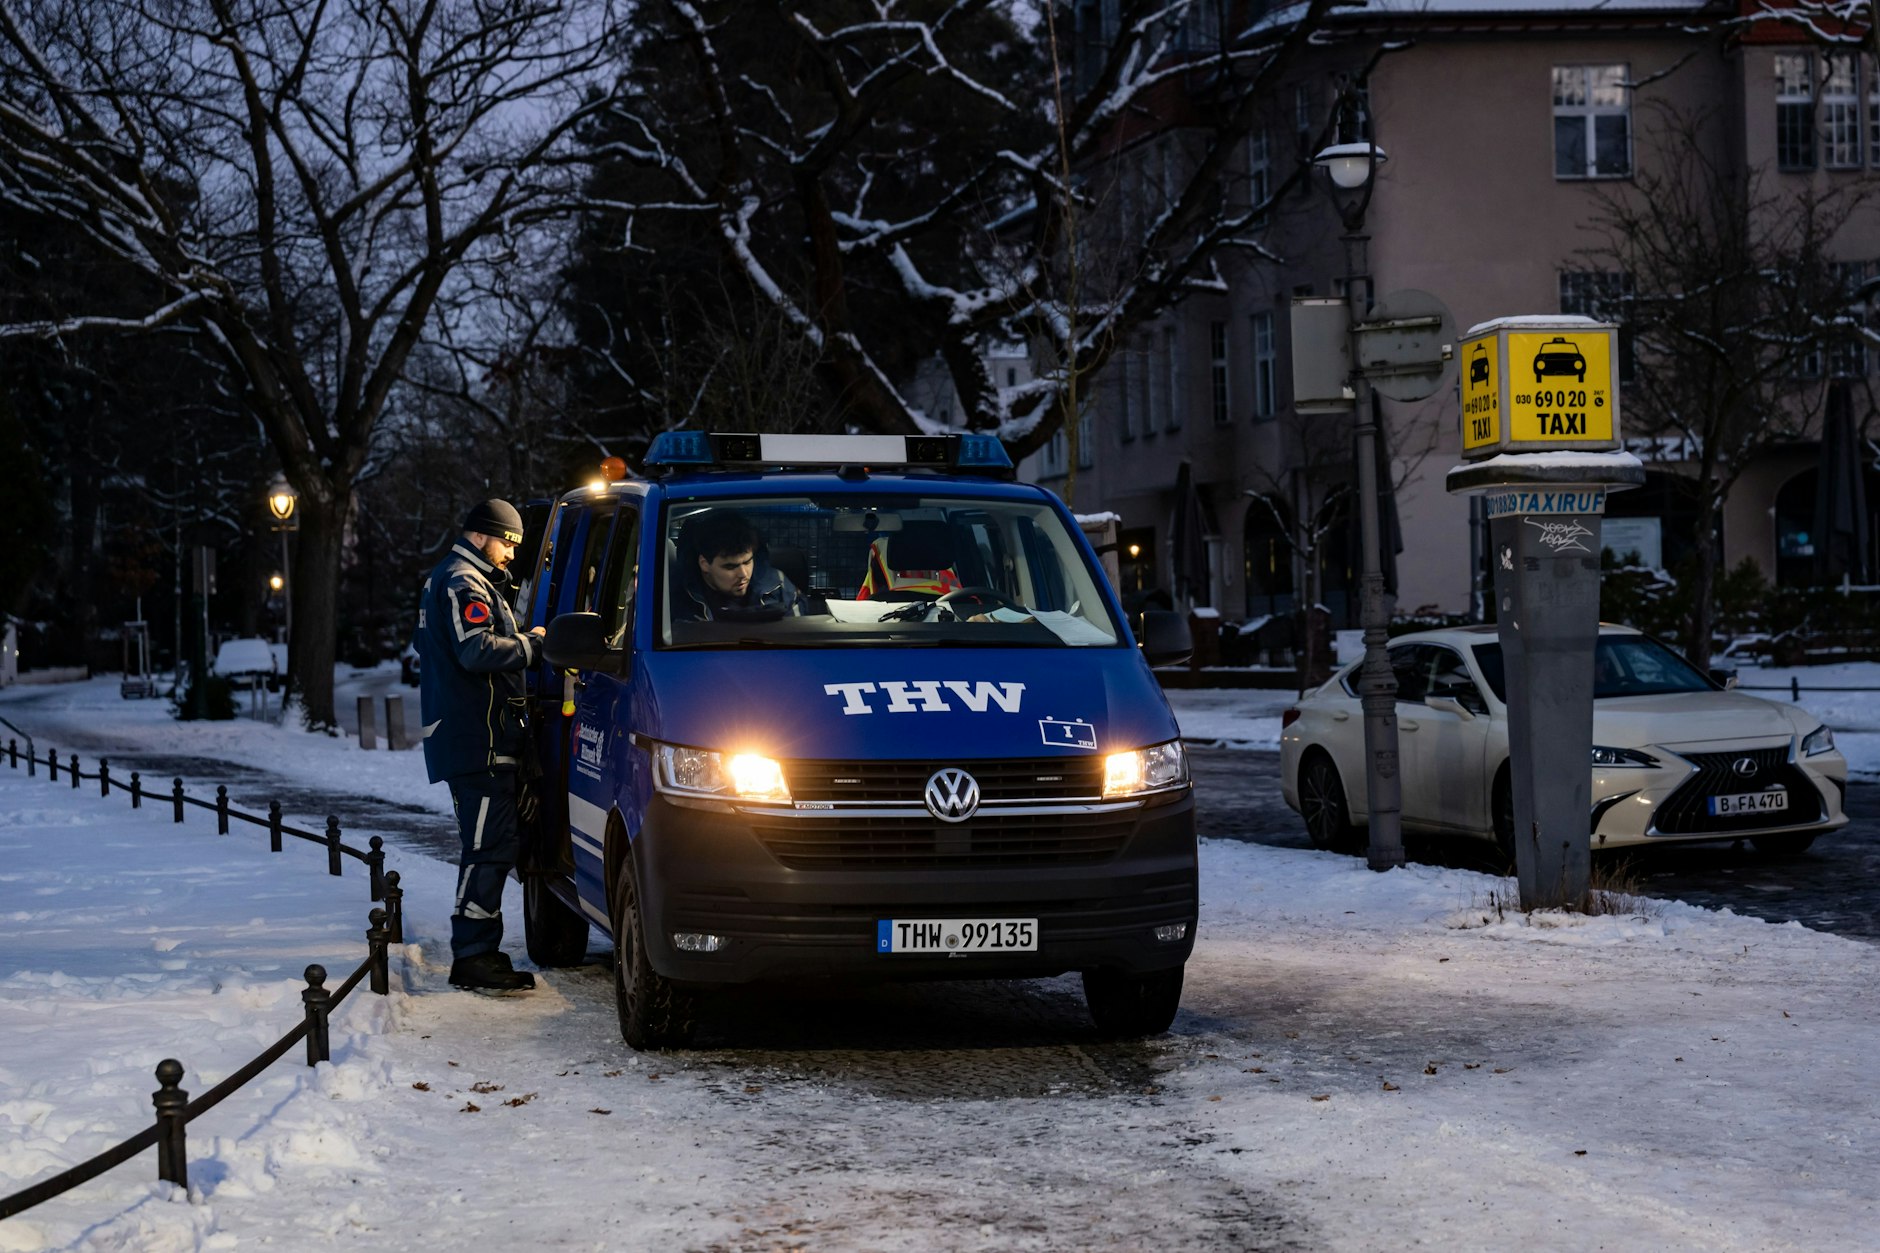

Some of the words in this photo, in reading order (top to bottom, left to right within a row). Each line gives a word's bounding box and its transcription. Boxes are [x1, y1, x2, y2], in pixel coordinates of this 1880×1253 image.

[1516, 394, 1531, 404] 030
[1472, 416, 1491, 441] TAXI
[1536, 413, 1586, 435] TAXI
[1519, 493, 1604, 512] TAXIRUF
[823, 680, 1027, 715] THW
[1721, 798, 1729, 812] B
[1738, 796, 1756, 810] FA
[1759, 793, 1783, 808] 470
[881, 939, 888, 948] D
[898, 923, 942, 948] THW
[962, 922, 1032, 948] 99135
